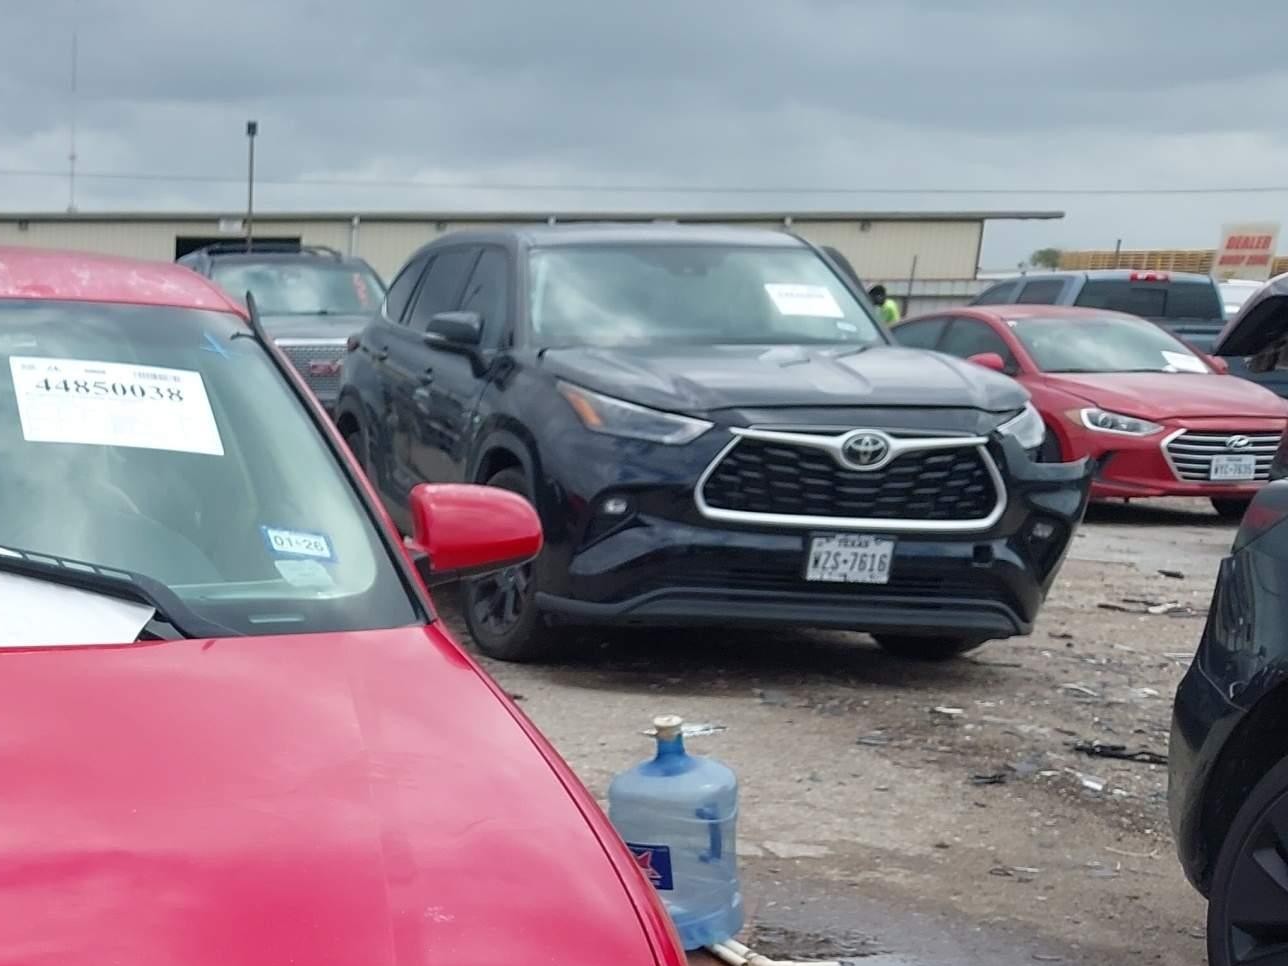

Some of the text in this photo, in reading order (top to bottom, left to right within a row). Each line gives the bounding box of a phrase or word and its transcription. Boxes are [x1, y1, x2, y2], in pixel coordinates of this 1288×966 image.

[1225, 235, 1272, 250] DEALER
[35, 377, 184, 402] 44850038
[273, 535, 324, 552] 01-26
